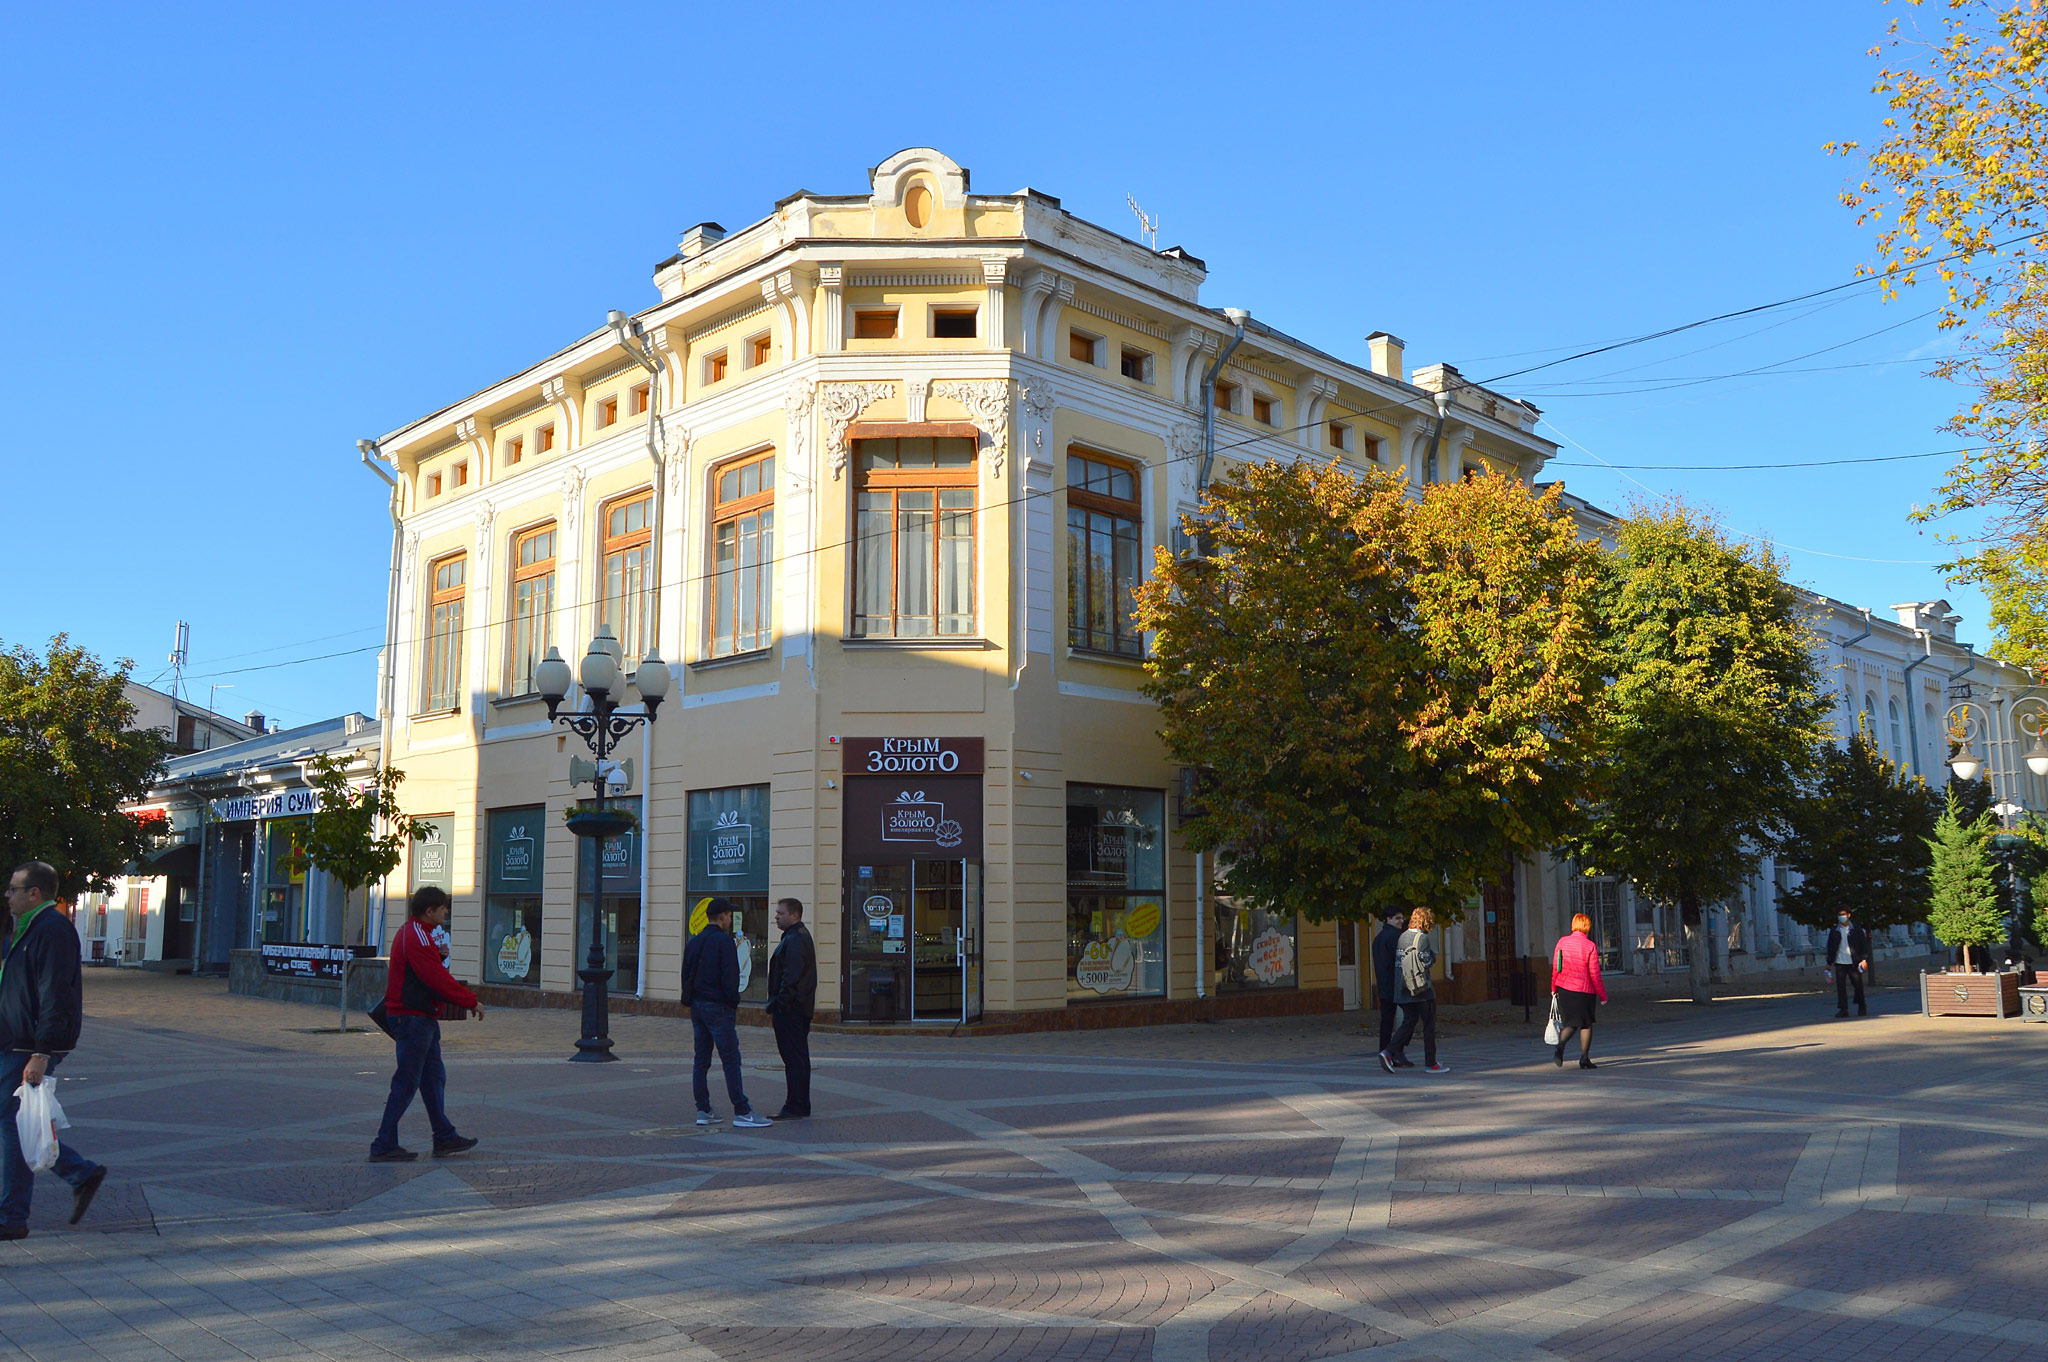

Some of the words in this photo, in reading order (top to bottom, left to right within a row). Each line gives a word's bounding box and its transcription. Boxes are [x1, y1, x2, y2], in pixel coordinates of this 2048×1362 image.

[883, 738, 940, 753] КРЫМ
[867, 751, 959, 772] ЗОЛОТО
[227, 796, 283, 818] ИМПЕРИЯ
